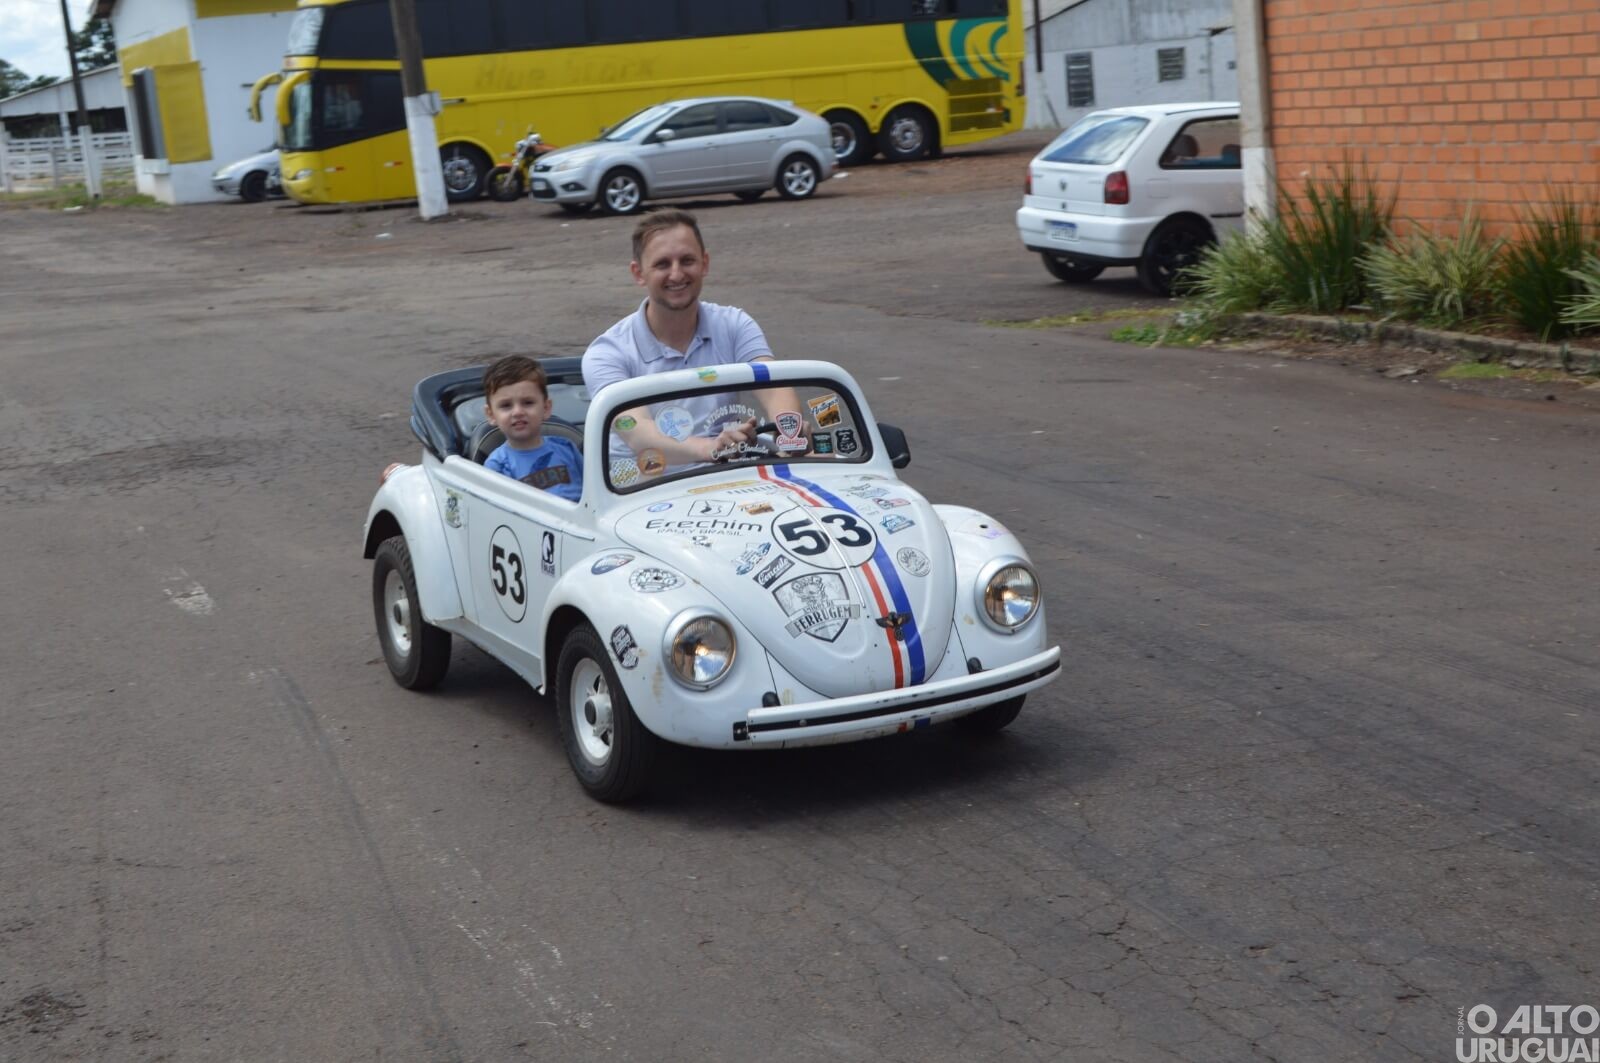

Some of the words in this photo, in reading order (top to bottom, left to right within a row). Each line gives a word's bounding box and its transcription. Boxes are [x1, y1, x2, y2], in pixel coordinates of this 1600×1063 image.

[729, 404, 746, 415] AUTO
[645, 518, 763, 532] Erechim
[778, 514, 872, 556] 53
[492, 543, 525, 605] 53
[794, 605, 852, 633] FERRUGEM
